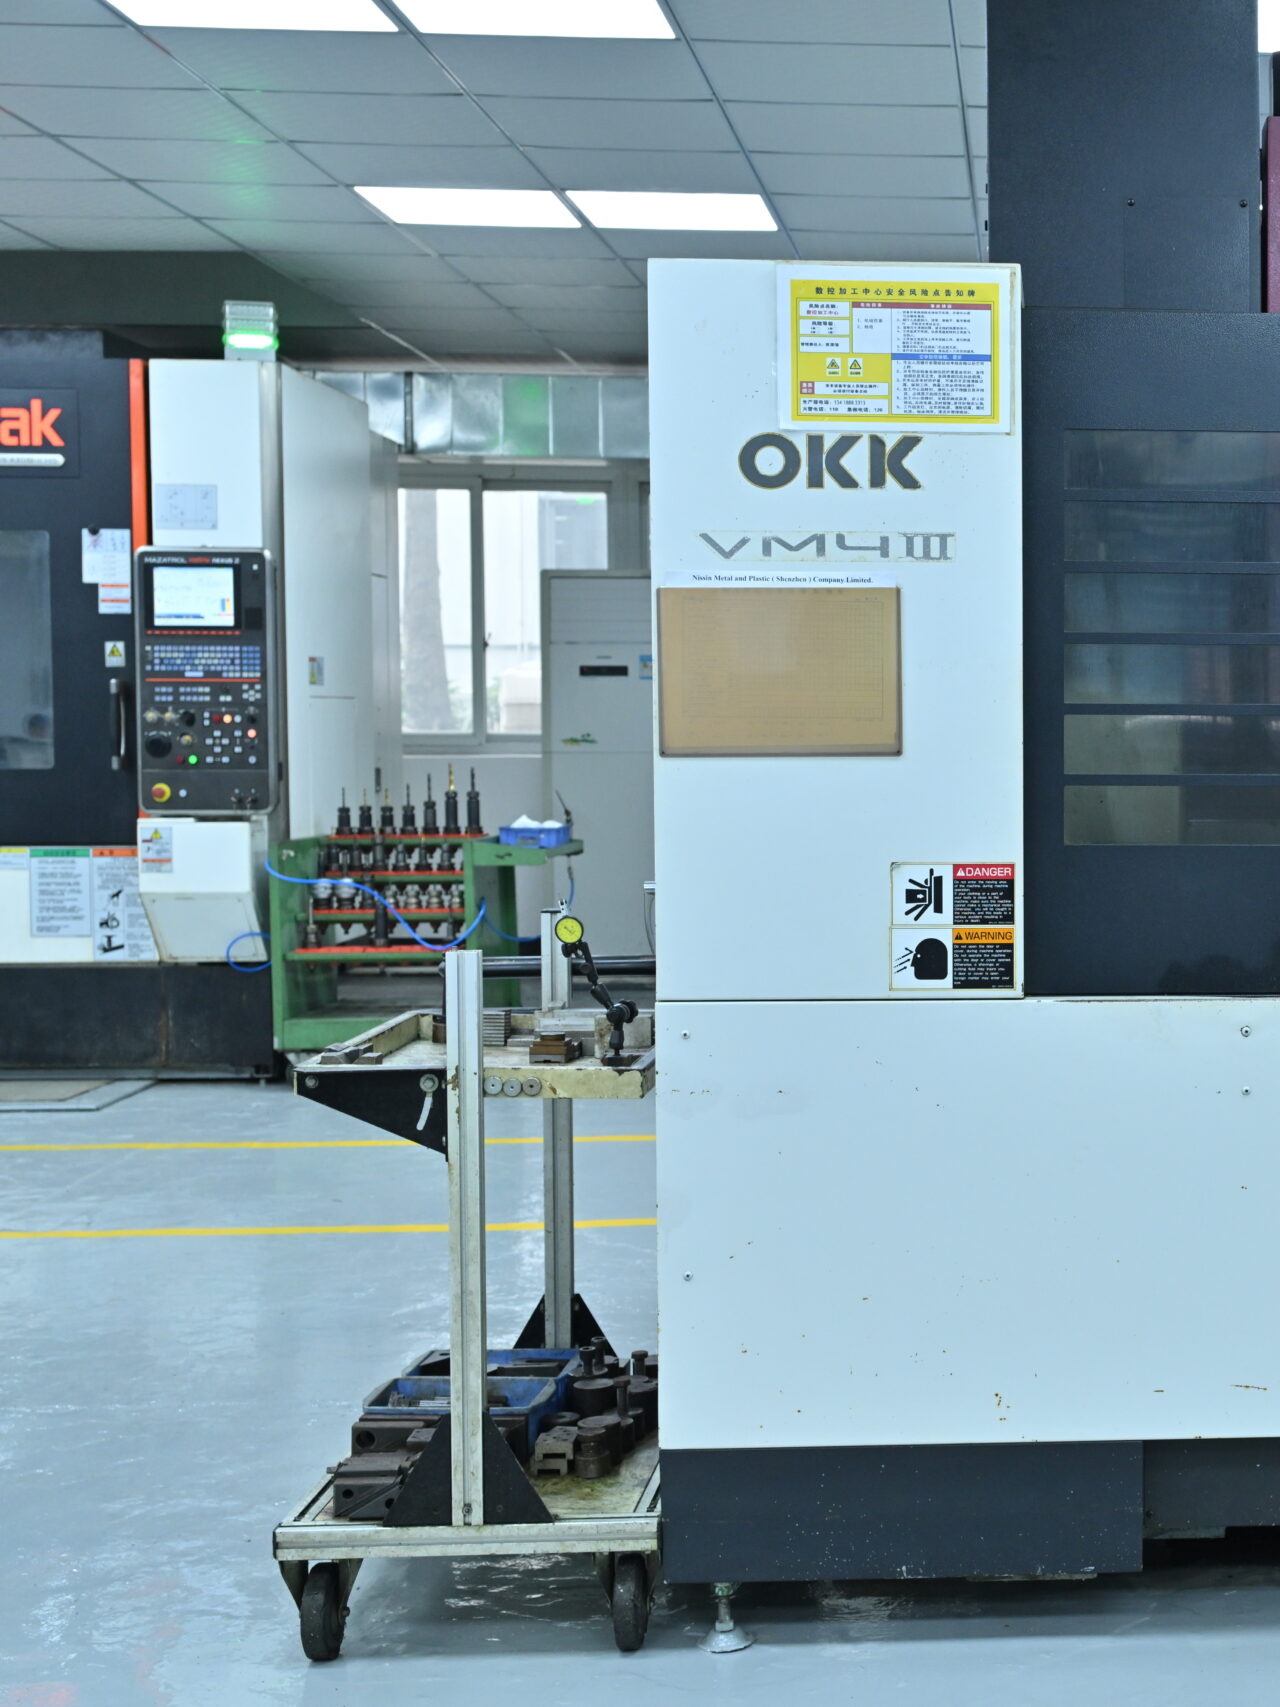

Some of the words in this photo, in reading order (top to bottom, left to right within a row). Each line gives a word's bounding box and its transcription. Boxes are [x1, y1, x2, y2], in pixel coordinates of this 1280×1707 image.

[738, 432, 923, 489] OKK
[812, 576, 844, 584] Company
[966, 867, 1012, 876] DANGER
[965, 931, 1013, 940] WARNING
